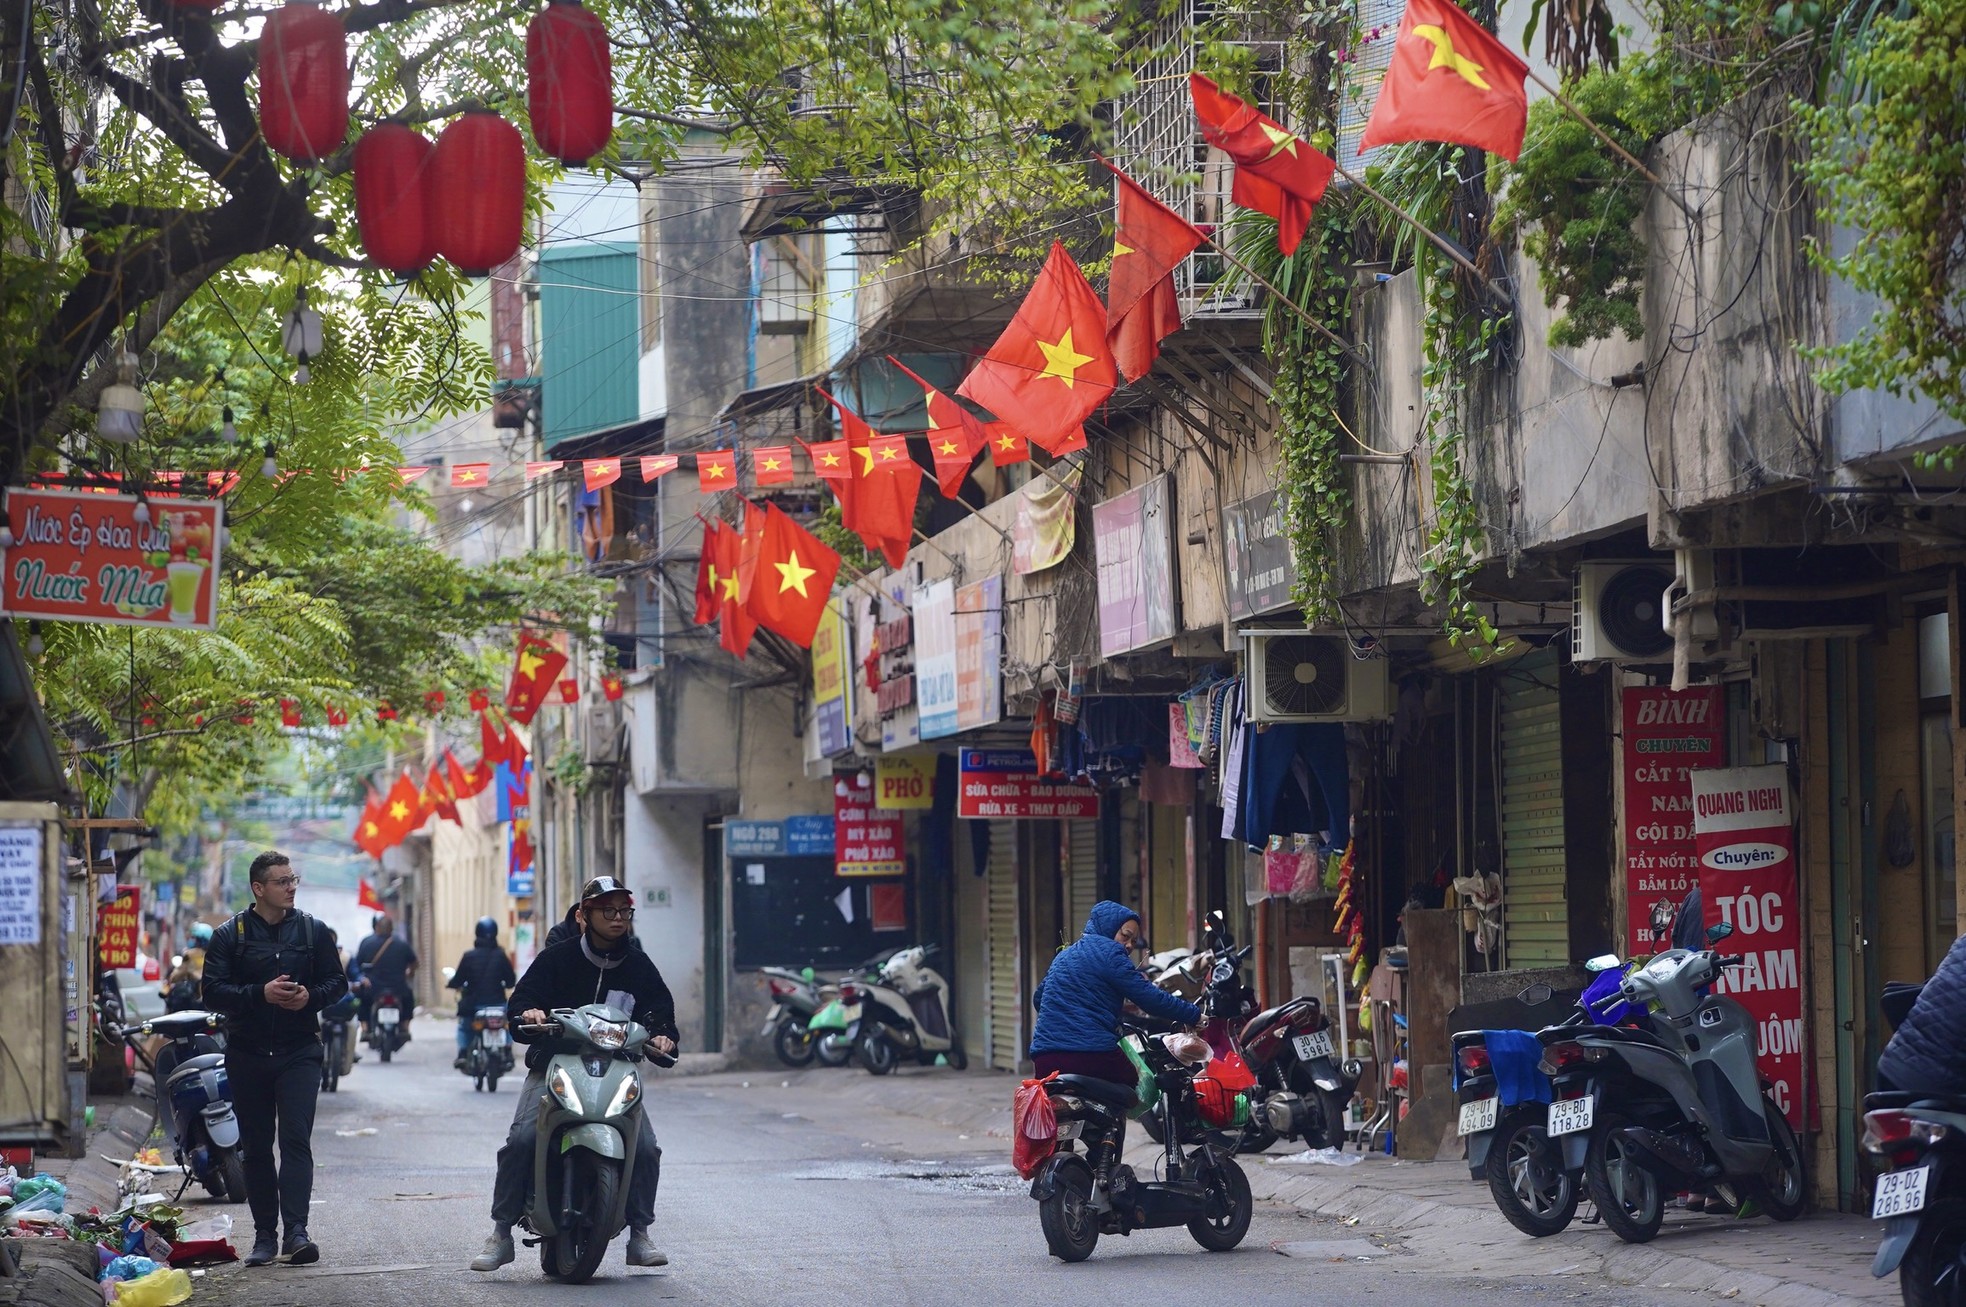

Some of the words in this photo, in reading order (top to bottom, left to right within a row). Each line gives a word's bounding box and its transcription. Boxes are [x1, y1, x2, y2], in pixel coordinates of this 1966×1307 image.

[99, 563, 167, 609] Mía
[1636, 692, 1710, 725] BÌNH
[1636, 735, 1712, 753] CHUYÊN
[1635, 760, 1672, 782] CẮT
[884, 767, 923, 798] PHỞ
[966, 781, 988, 796] SỬA
[991, 783, 1020, 796] CHỮA
[979, 800, 1001, 814] RỬA
[1004, 803, 1018, 814] XE
[1029, 803, 1055, 814] THAY
[1697, 791, 1744, 819] QUANG
[1747, 787, 1783, 814] NGHỊ
[1636, 821, 1668, 844] GỘI
[1659, 851, 1686, 868] NỐT
[1713, 848, 1775, 866] Chuyên:
[1716, 886, 1783, 935] TÓC
[1716, 949, 1798, 995] NAM
[1303, 1043, 1330, 1058] 5984
[1464, 1100, 1491, 1119] 29-U1
[1554, 1099, 1586, 1119] 29-BD
[1460, 1114, 1493, 1133] 494.09
[1552, 1114, 1589, 1134] 118.28
[1883, 1170, 1920, 1194] 29-D2
[1876, 1190, 1921, 1216] 286.96
